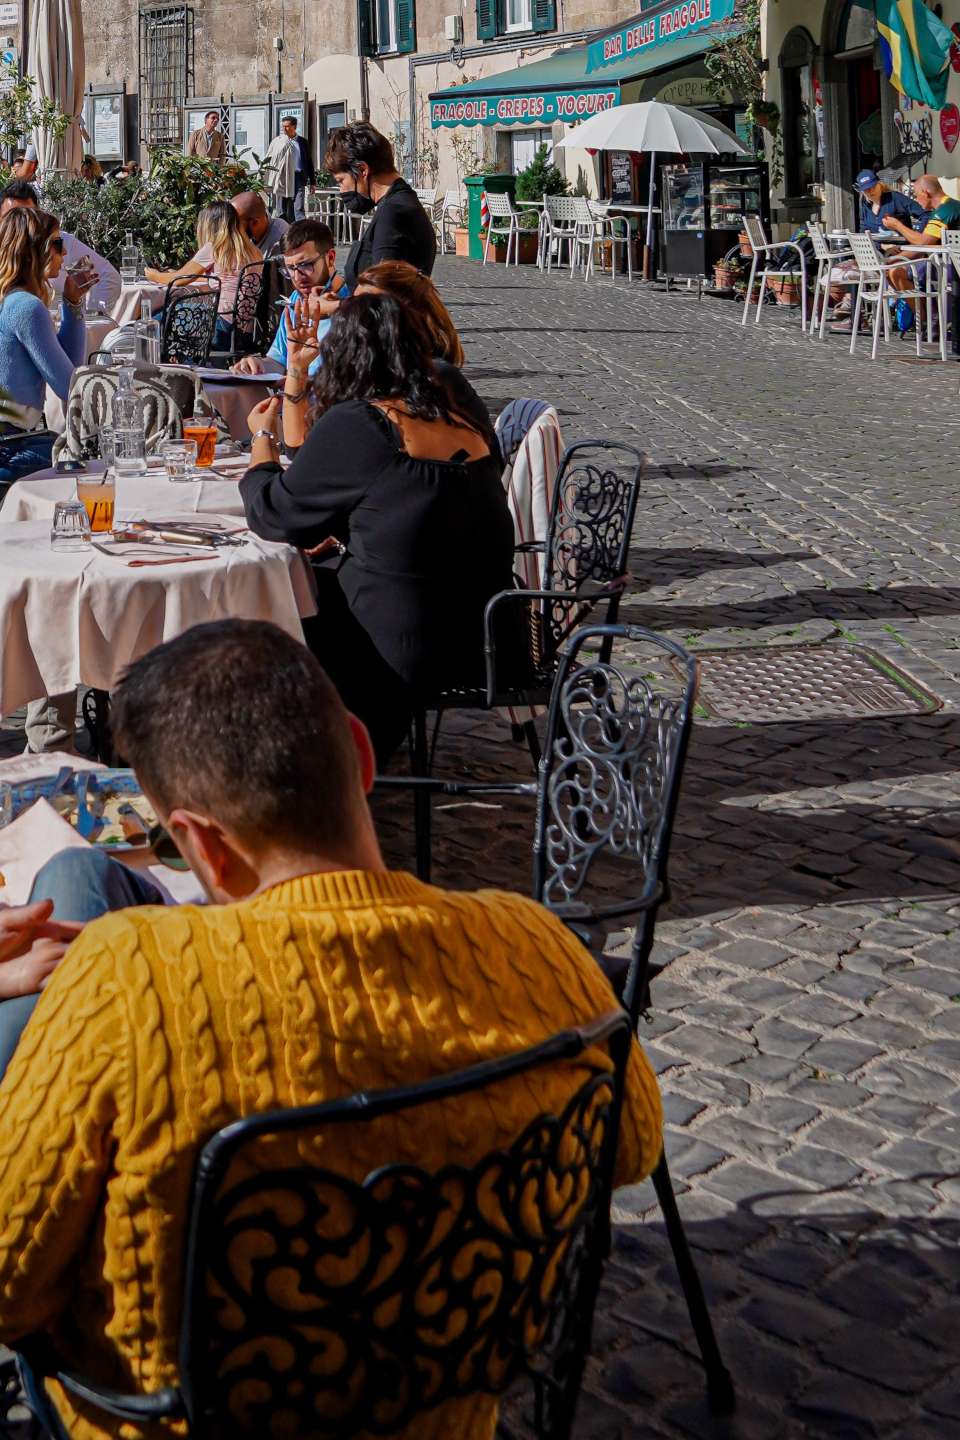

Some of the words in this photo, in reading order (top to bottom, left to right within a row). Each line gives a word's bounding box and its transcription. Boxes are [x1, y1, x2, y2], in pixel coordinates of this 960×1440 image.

[604, 35, 622, 60] BAR
[626, 20, 655, 51] DELLE
[432, 101, 487, 122] FRAGOLE
[497, 97, 544, 118] CREPES
[556, 92, 616, 116] YOGURT
